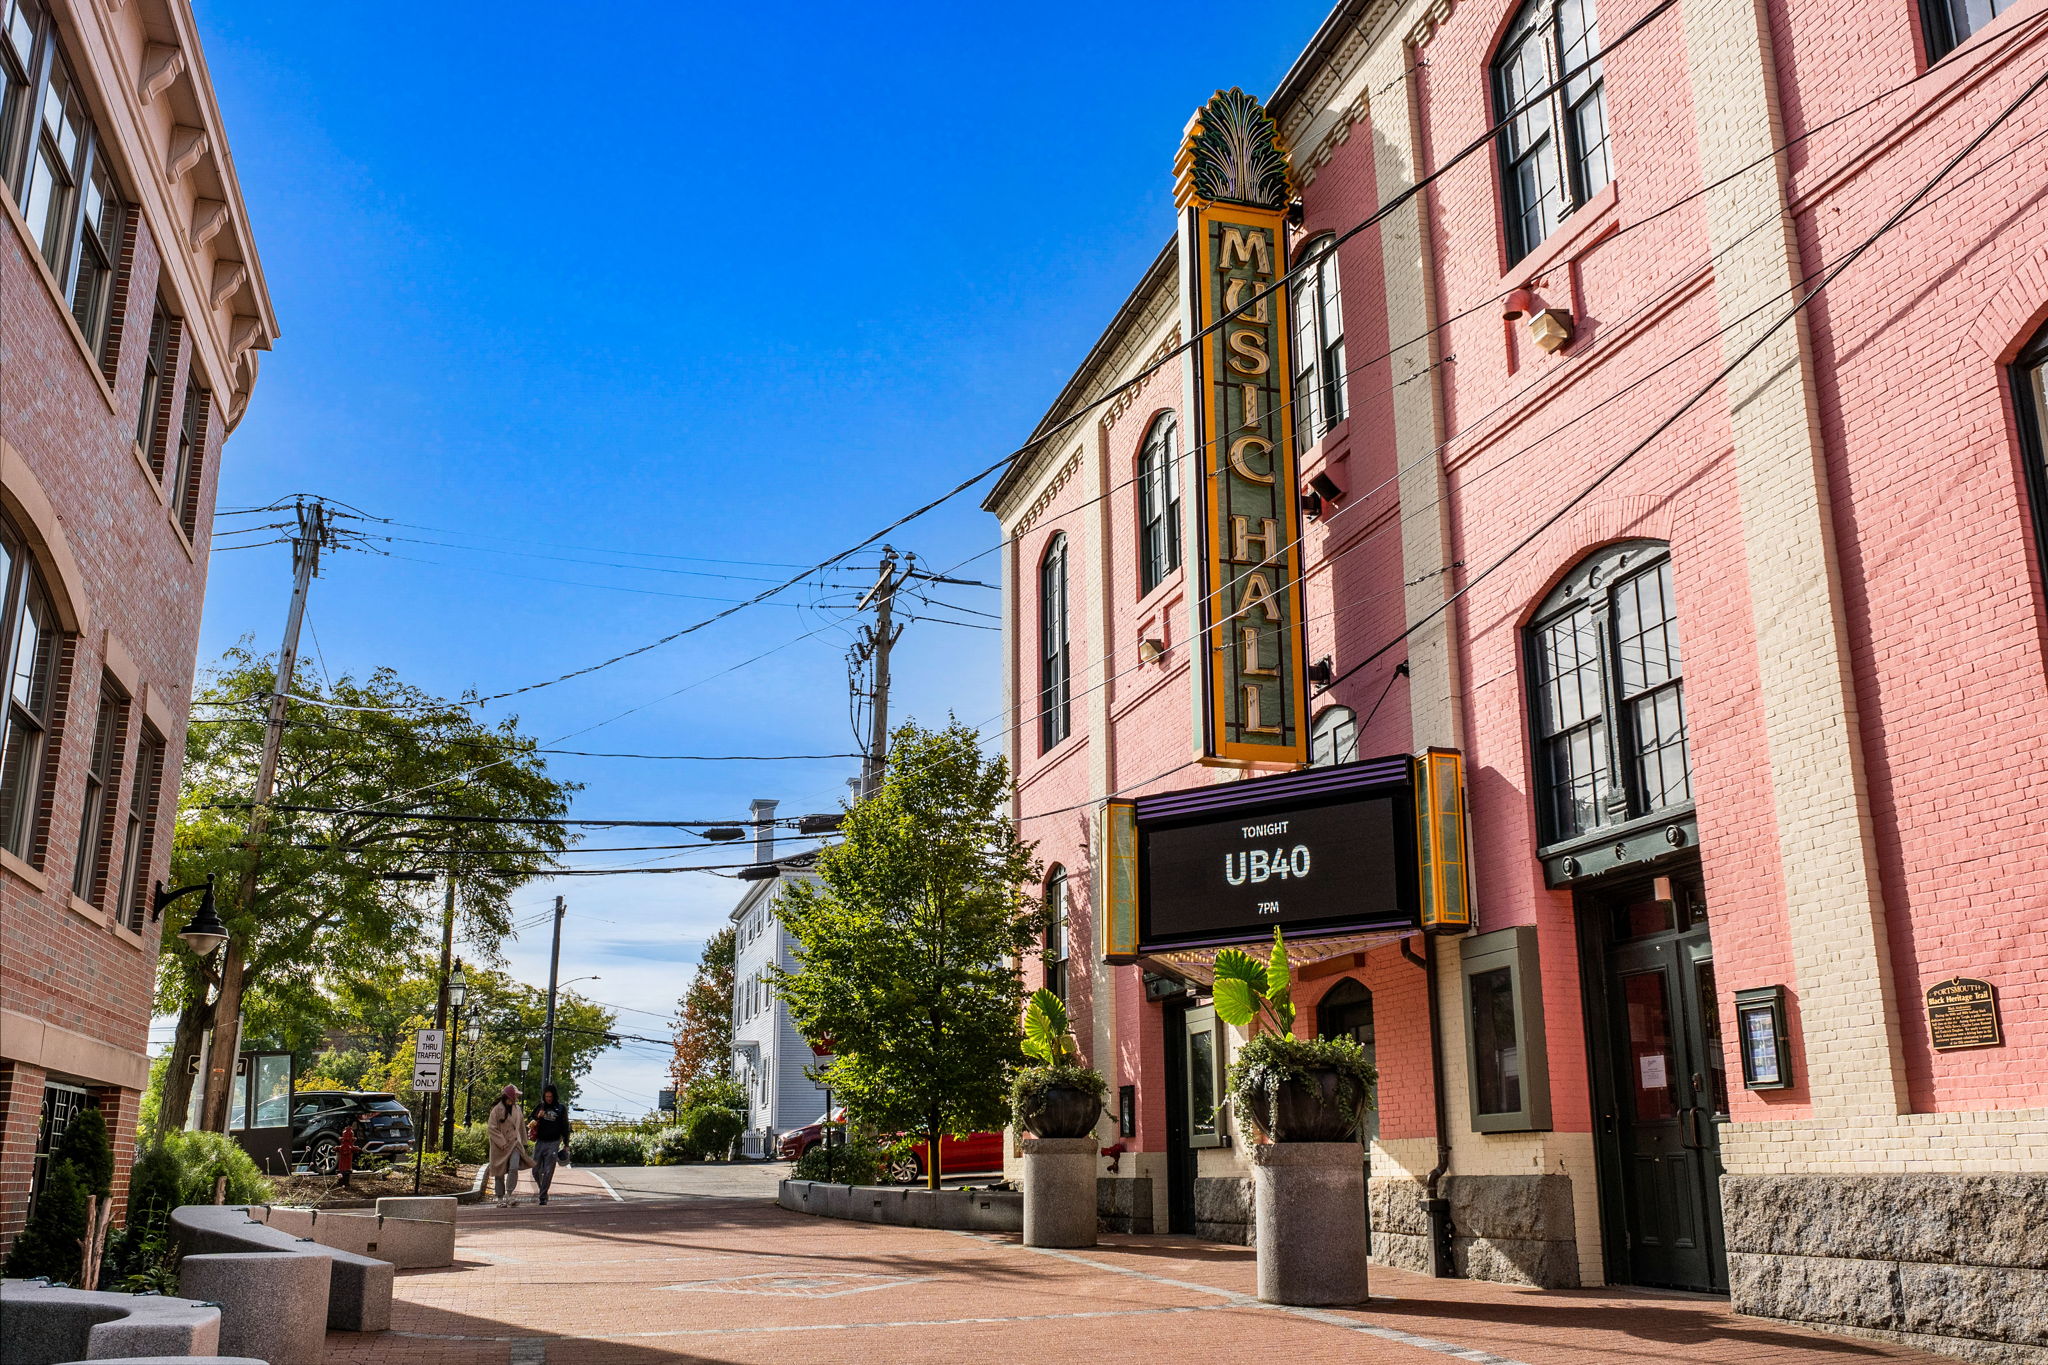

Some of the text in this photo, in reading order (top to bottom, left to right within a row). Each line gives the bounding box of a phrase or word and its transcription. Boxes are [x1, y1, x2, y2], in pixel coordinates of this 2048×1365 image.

[1217, 227, 1284, 735] MUSIC HALL
[1242, 821, 1288, 838] TONIGHT
[1225, 844, 1310, 885] UB40
[1257, 901, 1279, 914] 7PM
[1928, 991, 1988, 1005] Black Heritage Trail
[1933, 985, 1980, 996] PORTSMOUTH
